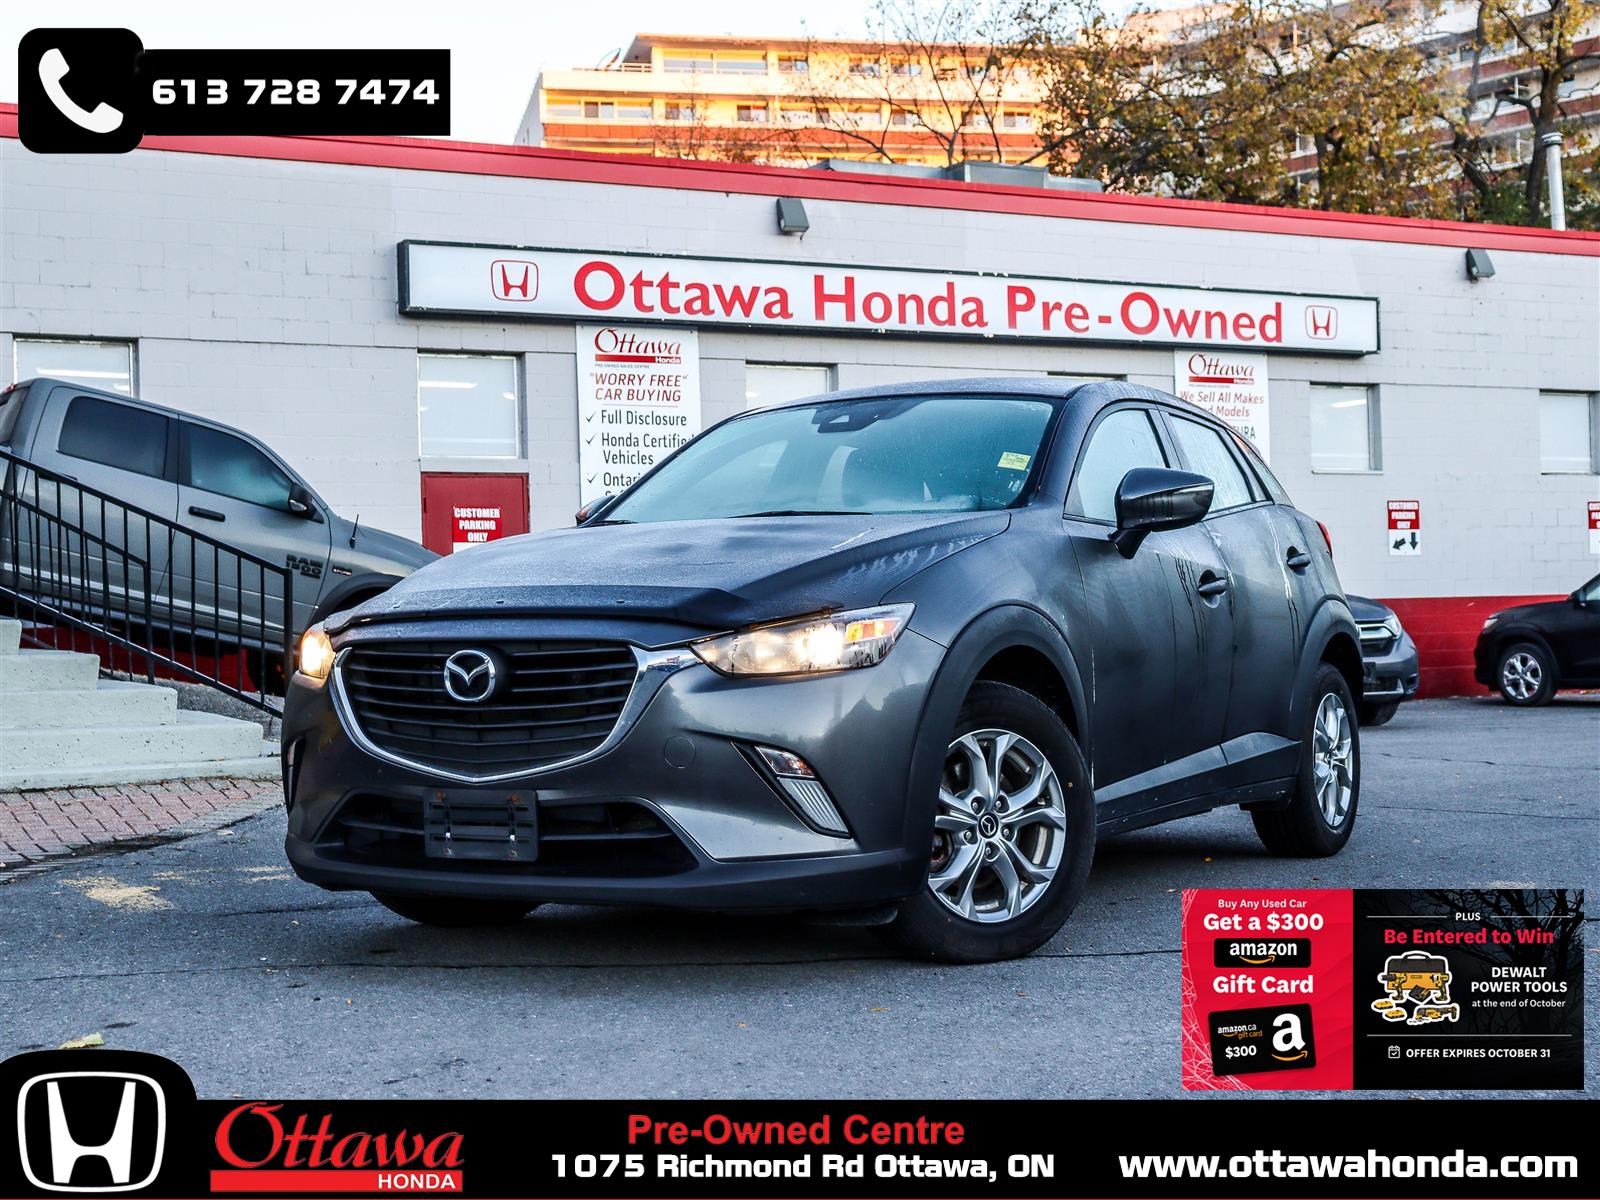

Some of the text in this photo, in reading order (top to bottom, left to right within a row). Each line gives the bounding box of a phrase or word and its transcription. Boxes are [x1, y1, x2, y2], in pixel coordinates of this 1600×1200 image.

[574, 260, 793, 319] Ottawa
[814, 274, 988, 328] Honda
[1007, 285, 1282, 343] Pre-Owned
[594, 327, 681, 355] Ottawa
[1188, 352, 1254, 377] Ottawa
[595, 388, 681, 402] CAR BUYING
[1180, 391, 1264, 405] We Sell All Makes
[601, 410, 687, 426] Full Disclosure
[1216, 406, 1250, 417] Models
[602, 432, 695, 449] Honda Certifie
[603, 449, 654, 465] Vehicles
[454, 508, 500, 518] CUSTOMER
[458, 520, 496, 530] PARKING
[467, 532, 488, 542] ONLY
